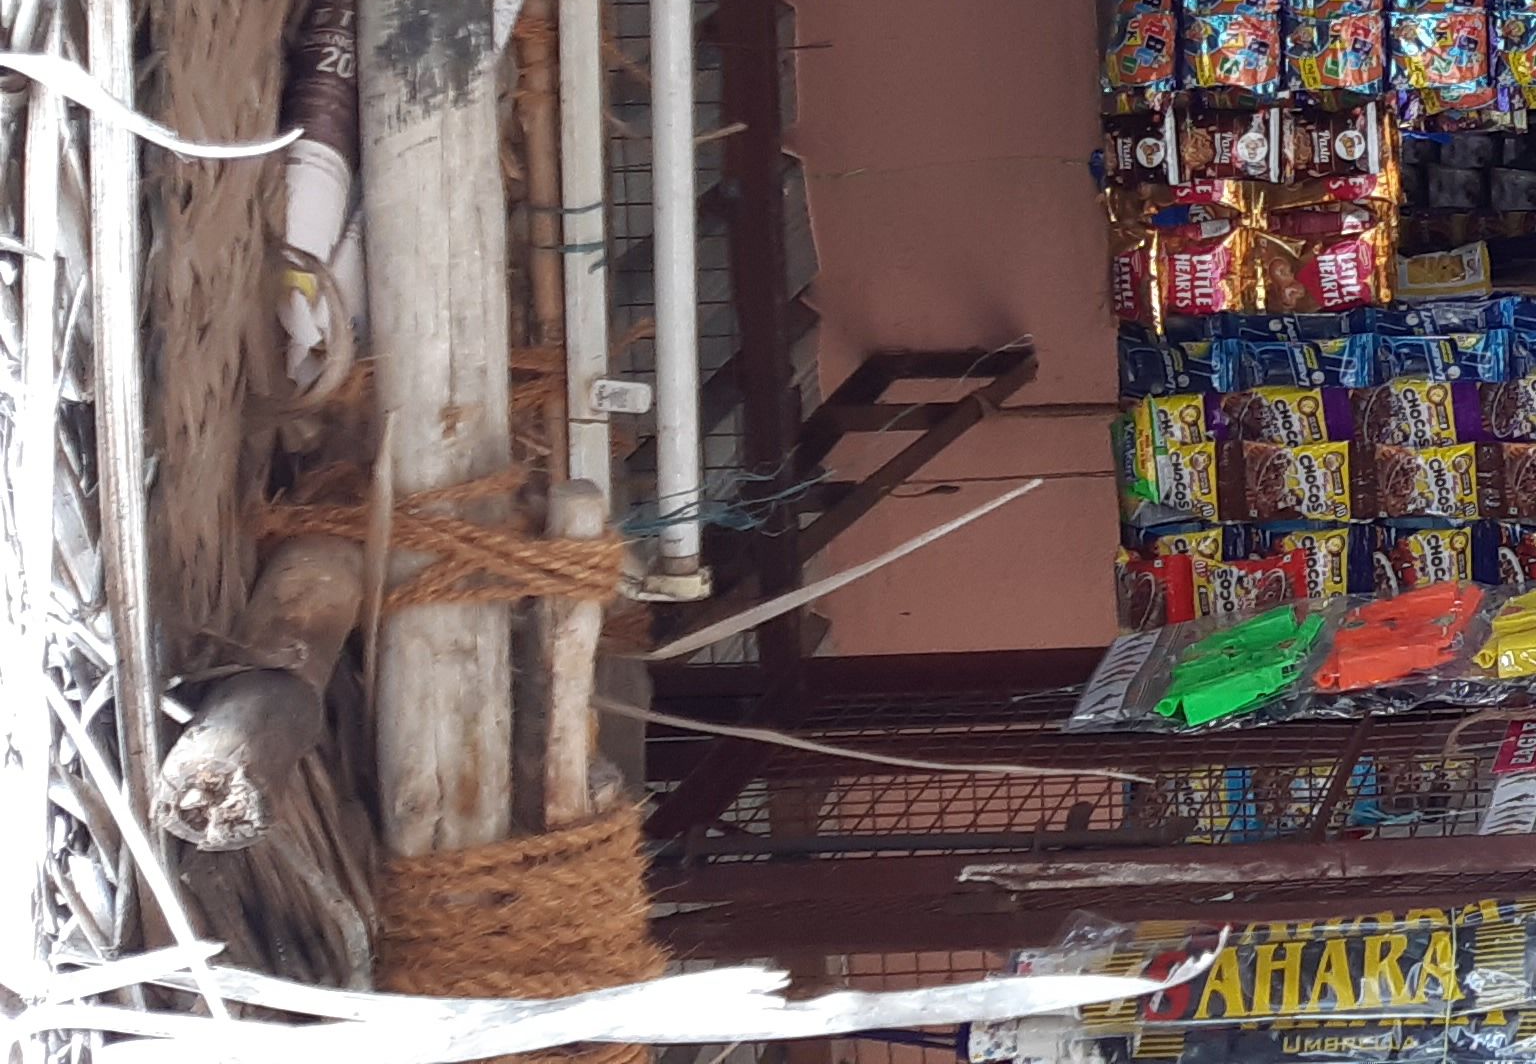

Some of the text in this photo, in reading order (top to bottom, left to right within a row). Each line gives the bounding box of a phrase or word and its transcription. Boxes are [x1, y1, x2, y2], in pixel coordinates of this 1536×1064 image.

[1221, 132, 1232, 164] Pasta
[1319, 130, 1330, 163] Pasta
[1119, 256, 1134, 309] LITTLE
[1173, 255, 1191, 307] HEARTS
[1194, 255, 1213, 305] LITTLE
[1316, 255, 1342, 306] HEARTS
[1336, 252, 1361, 302] LITTLE
[1274, 399, 1299, 447] CHOCO
[1402, 388, 1430, 448] CHOCOS
[1171, 451, 1192, 509] CHOCOS
[1299, 454, 1322, 513] CHOCOS
[1428, 458, 1450, 513] CHOCOS
[1202, 502, 1215, 517] 10
[1335, 502, 1347, 517] 10
[1463, 503, 1475, 516] 10
[1301, 536, 1321, 599] CHOCOS
[1427, 535, 1445, 579] CHOC
[1217, 570, 1235, 611] OCOS
